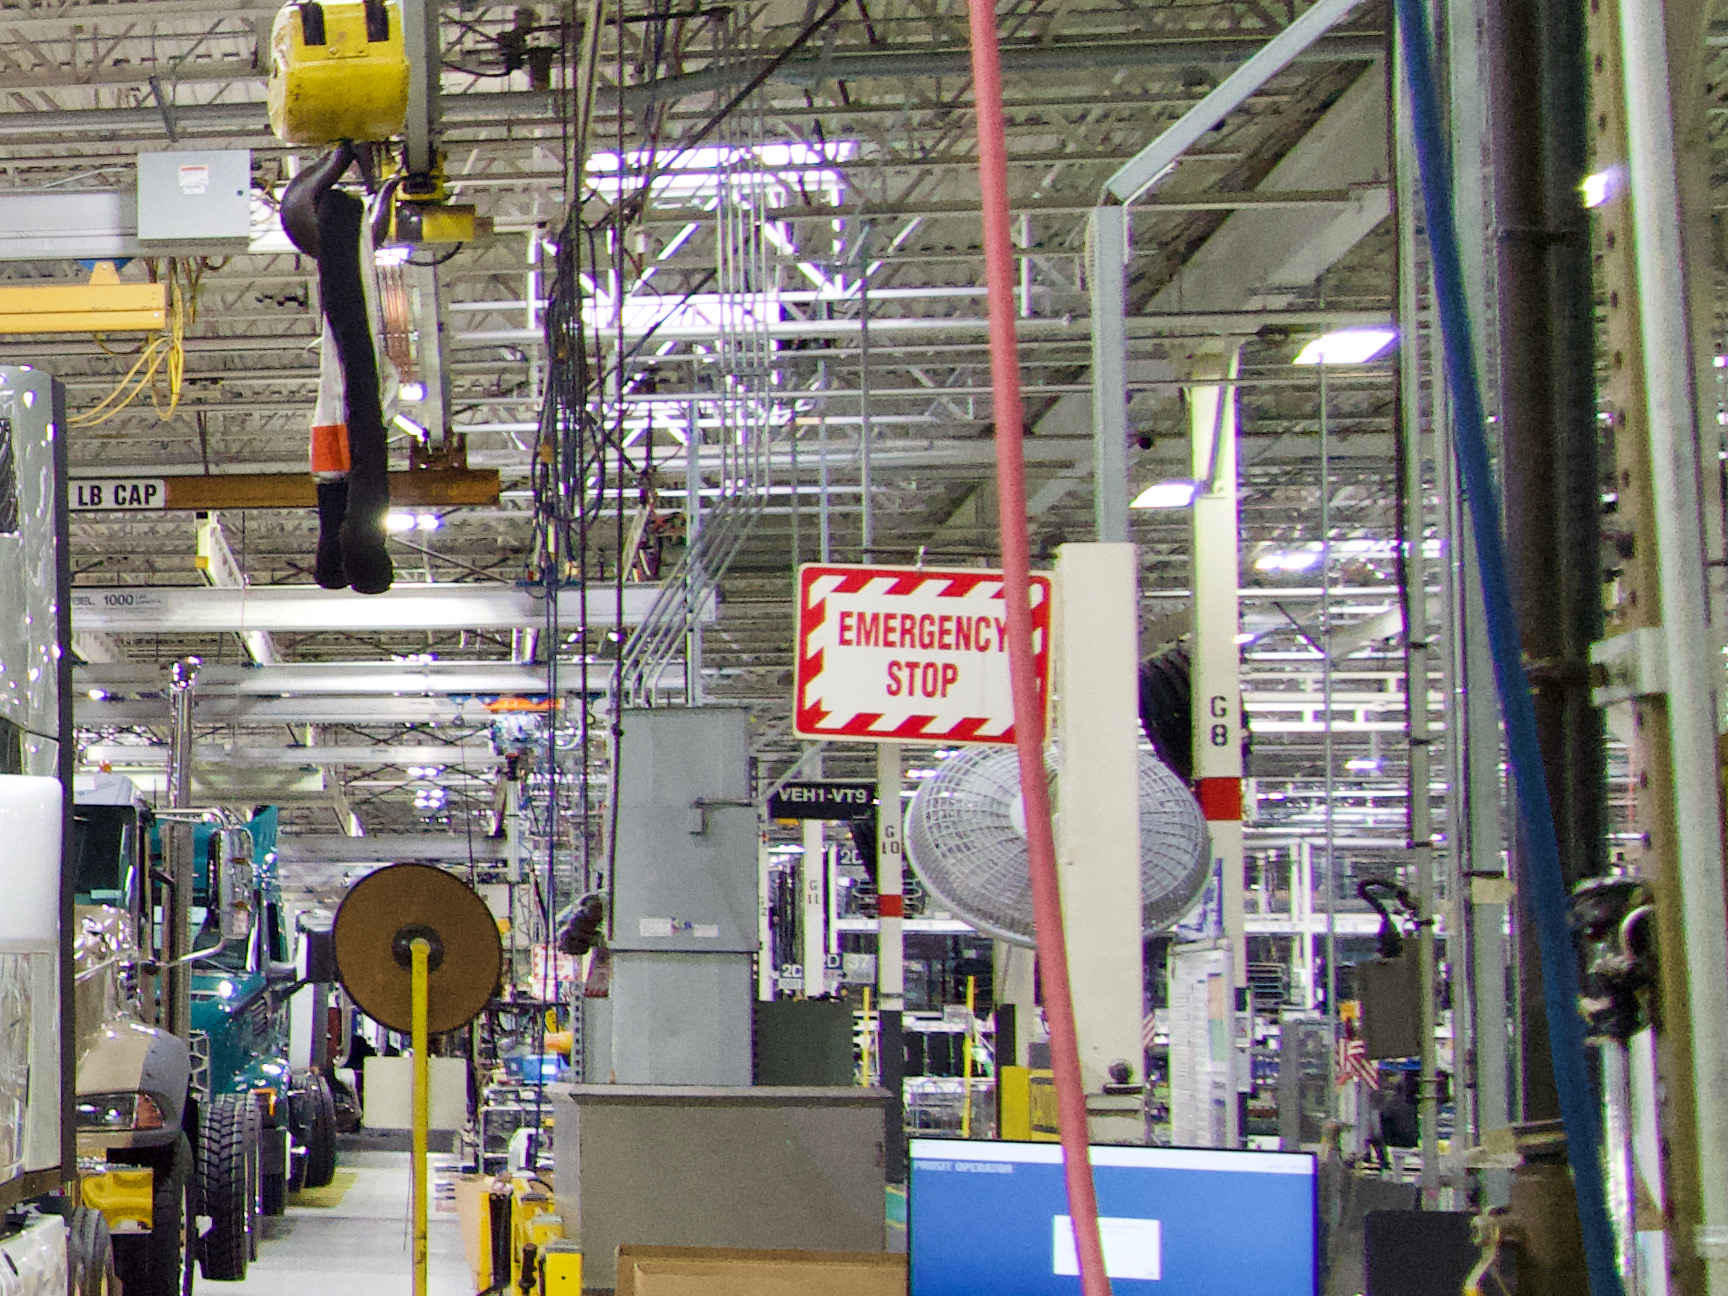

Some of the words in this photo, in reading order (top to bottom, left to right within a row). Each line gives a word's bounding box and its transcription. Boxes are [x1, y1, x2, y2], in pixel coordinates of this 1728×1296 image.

[78, 485, 103, 507] LB
[114, 483, 158, 507] CAP
[104, 594, 135, 606] 1000
[838, 610, 1008, 653] EMERGENCY
[885, 659, 959, 698] STOP
[1210, 695, 1228, 718] G
[1211, 724, 1229, 746] 8
[779, 787, 868, 804] VEH1-VT9
[885, 824, 895, 839] G
